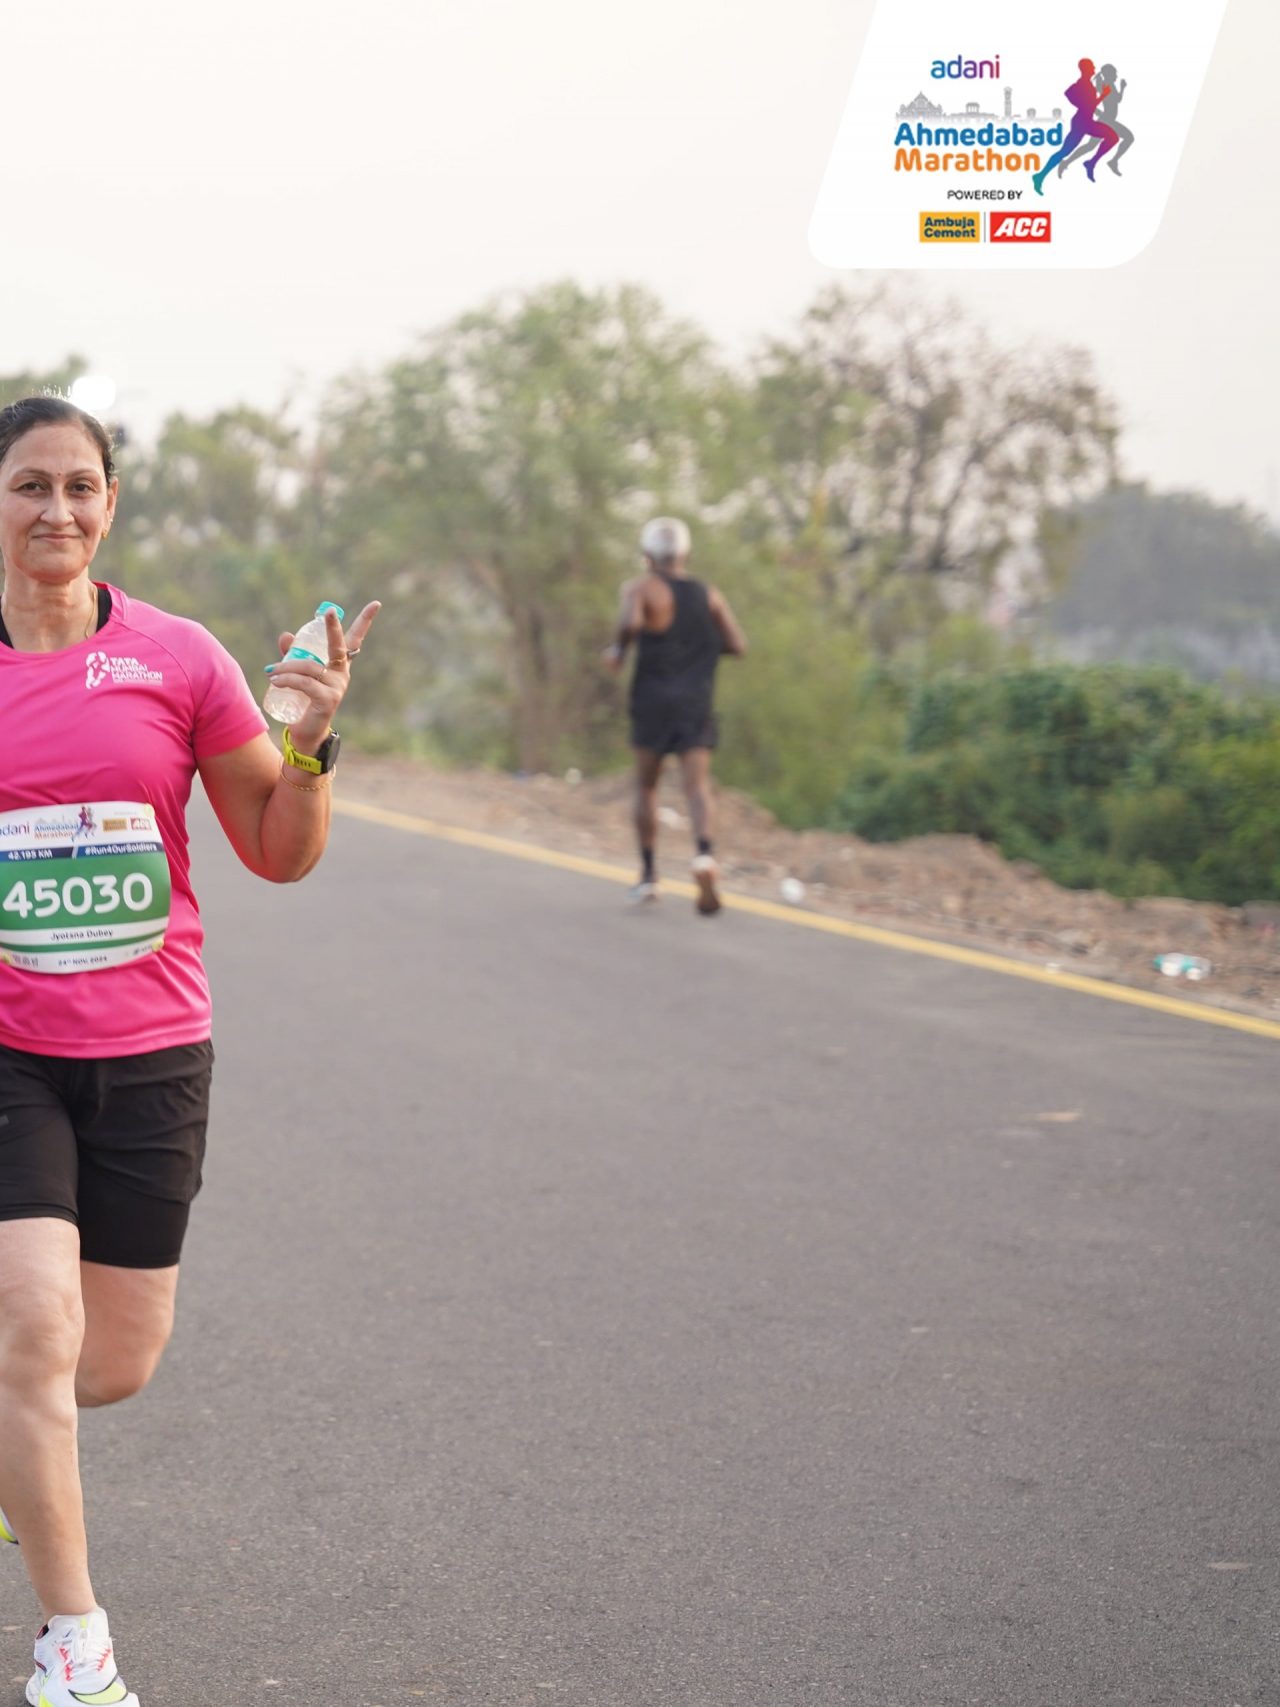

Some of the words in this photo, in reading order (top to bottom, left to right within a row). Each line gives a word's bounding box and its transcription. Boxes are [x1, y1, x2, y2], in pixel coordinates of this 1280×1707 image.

[110, 657, 139, 666] TATA
[112, 671, 163, 681] MARATHON
[34, 823, 79, 833] Ahmedabad
[34, 831, 74, 840] Marathon
[39, 849, 53, 859] KM
[2, 872, 153, 919] 45030
[87, 929, 113, 939] Dubey
